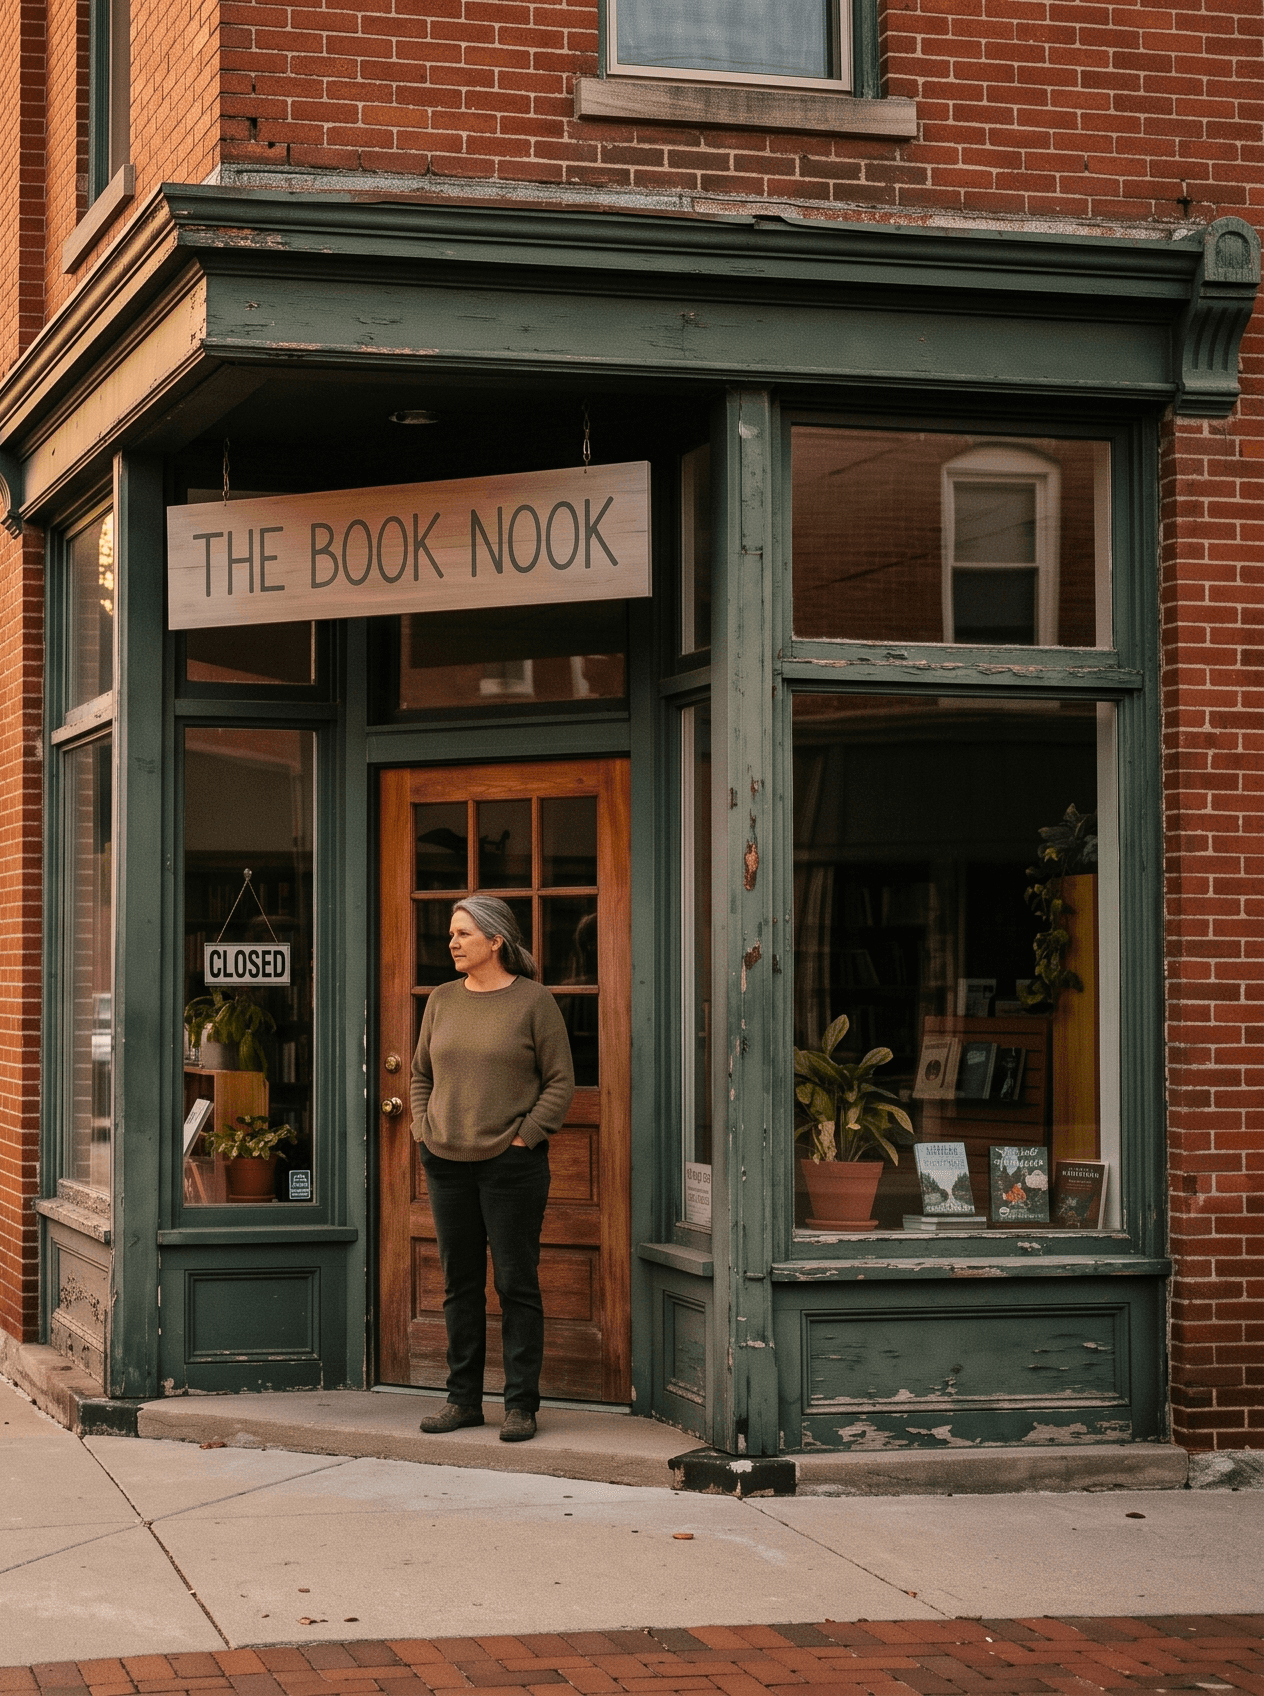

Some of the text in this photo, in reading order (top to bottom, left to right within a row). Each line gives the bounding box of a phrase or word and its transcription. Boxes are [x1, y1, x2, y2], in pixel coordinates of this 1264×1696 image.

[192, 495, 619, 598] THE BOOK NOOK
[209, 949, 286, 979] CLOSED
